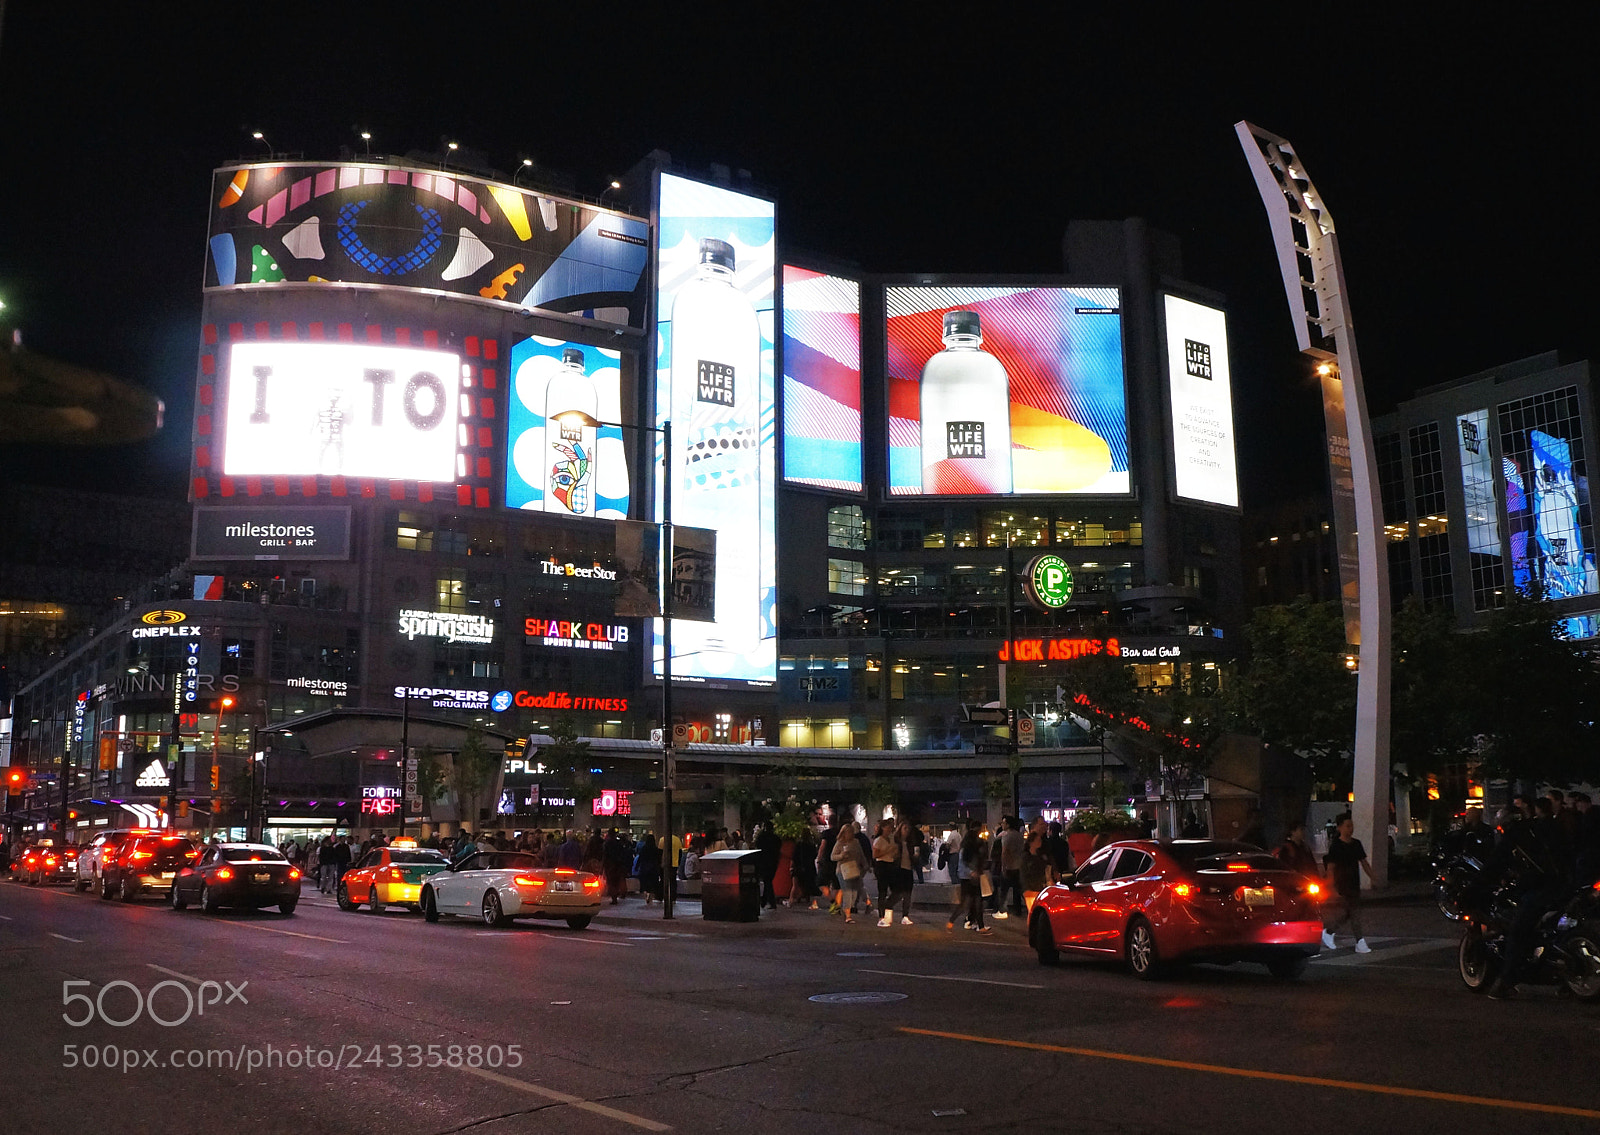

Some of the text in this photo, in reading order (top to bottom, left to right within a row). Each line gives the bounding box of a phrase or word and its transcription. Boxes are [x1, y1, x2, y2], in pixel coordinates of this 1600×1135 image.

[1187, 350, 1210, 365] LIFE
[1187, 361, 1211, 377] WTR
[699, 370, 733, 389] LIFE
[249, 365, 447, 431] I TO
[699, 384, 733, 403] WTR
[949, 431, 982, 443] LIFE
[949, 444, 983, 456] WTR
[225, 521, 315, 537] milestones
[259, 539, 286, 547] GRILL
[540, 560, 617, 581] The Beer Stor
[1036, 557, 1071, 578] MUNICIPAL
[1046, 568, 1063, 589] P
[1036, 583, 1072, 606] PARKING
[132, 625, 202, 639] CINEPLEX
[524, 618, 629, 643] SHARK CLUB
[543, 636, 614, 651] SPORTS BAR GRILL
[1120, 646, 1141, 658] Bar
[1142, 646, 1157, 657] and
[1158, 646, 1181, 658] Grill
[185, 642, 200, 702] Yonge
[287, 676, 348, 690] milestones
[174, 672, 183, 715] DOWNTOWN
[393, 686, 628, 712] SHOPPERS GoodLife FITNESS
[432, 700, 489, 710] DRUG MART
[362, 787, 385, 798] FOR
